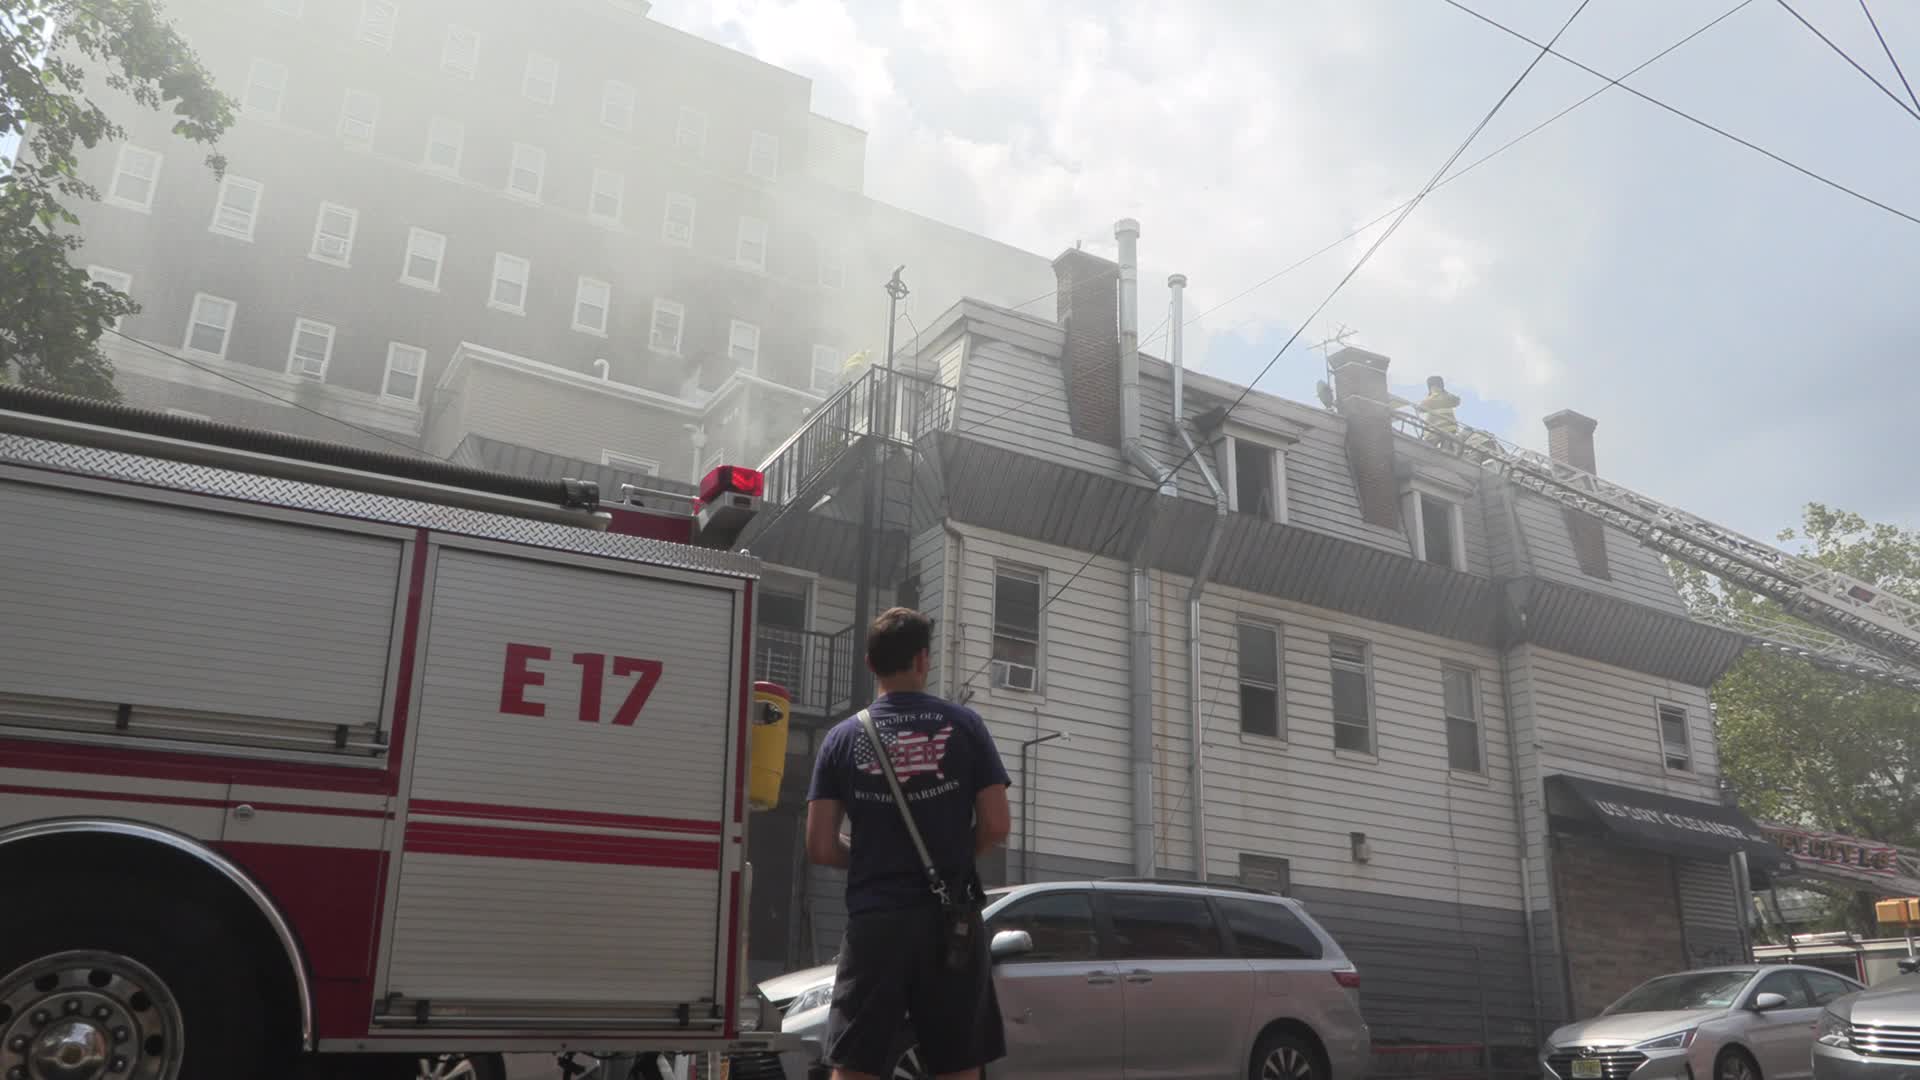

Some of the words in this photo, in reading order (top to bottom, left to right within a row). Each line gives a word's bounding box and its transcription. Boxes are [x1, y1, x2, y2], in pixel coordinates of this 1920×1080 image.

[499, 642, 552, 718] E
[572, 652, 664, 727] 17
[874, 713, 917, 728] PPORTS
[919, 711, 944, 722] OUR
